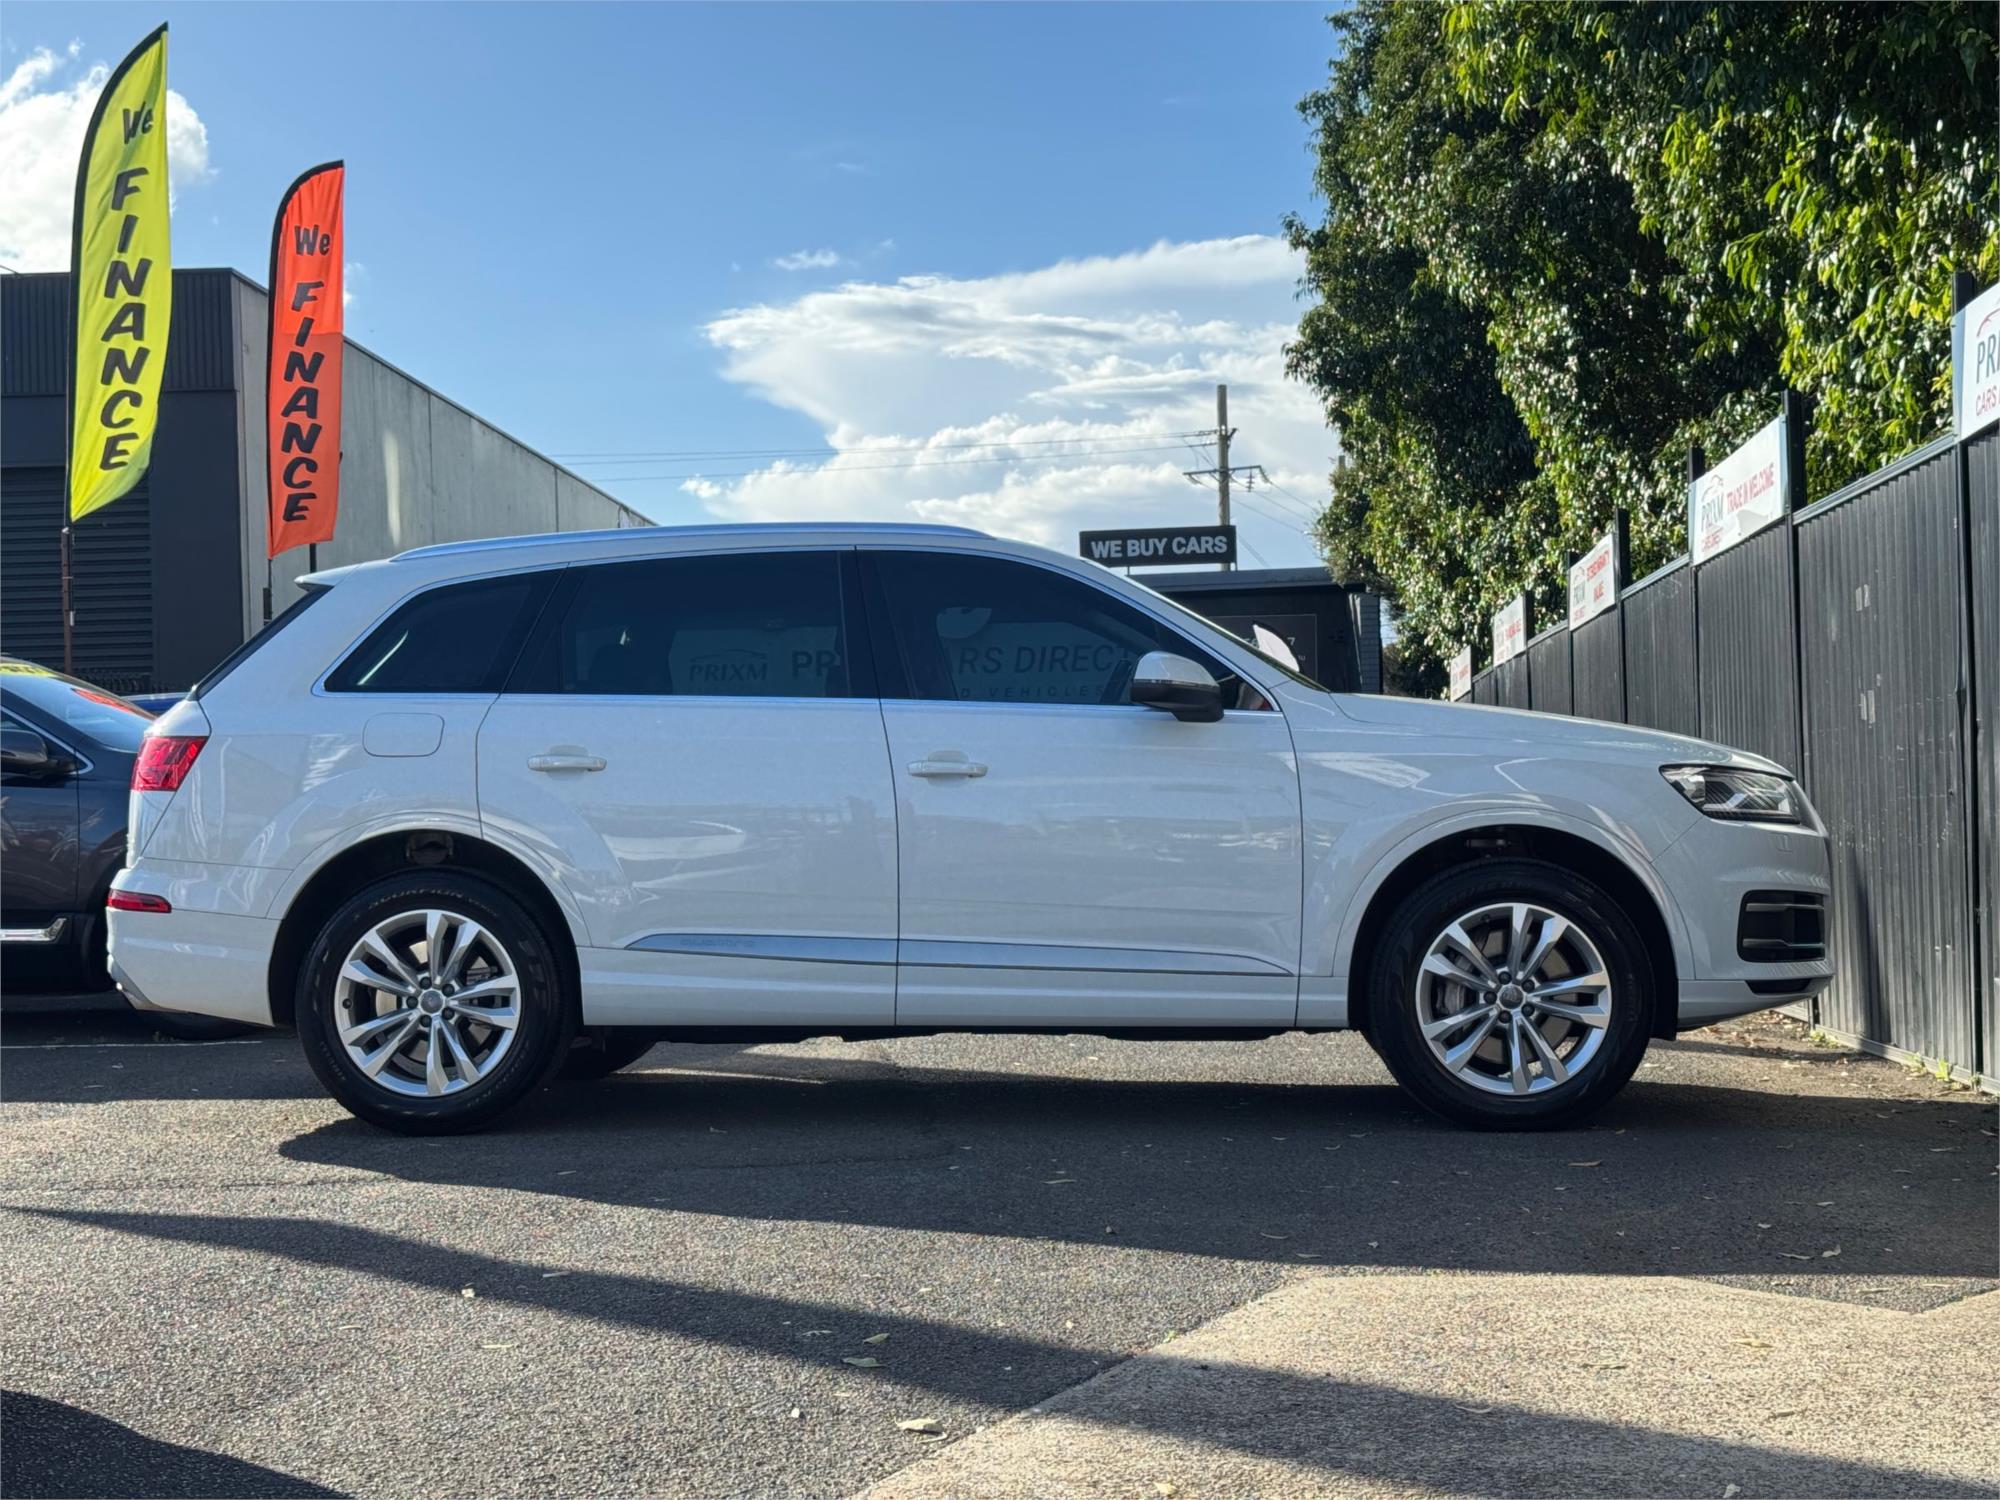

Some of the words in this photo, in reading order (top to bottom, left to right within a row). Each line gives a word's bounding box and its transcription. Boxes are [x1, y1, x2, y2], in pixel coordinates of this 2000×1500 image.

[122, 101, 154, 145] We
[294, 225, 331, 256] We
[100, 167, 153, 471] FINANCE
[281, 281, 325, 522] FINANCE
[1091, 540, 1123, 559] WE
[1127, 537, 1168, 557] BUY
[1172, 535, 1228, 555] CARS
[689, 663, 768, 682] PRIXM
[958, 646, 1005, 674] RS
